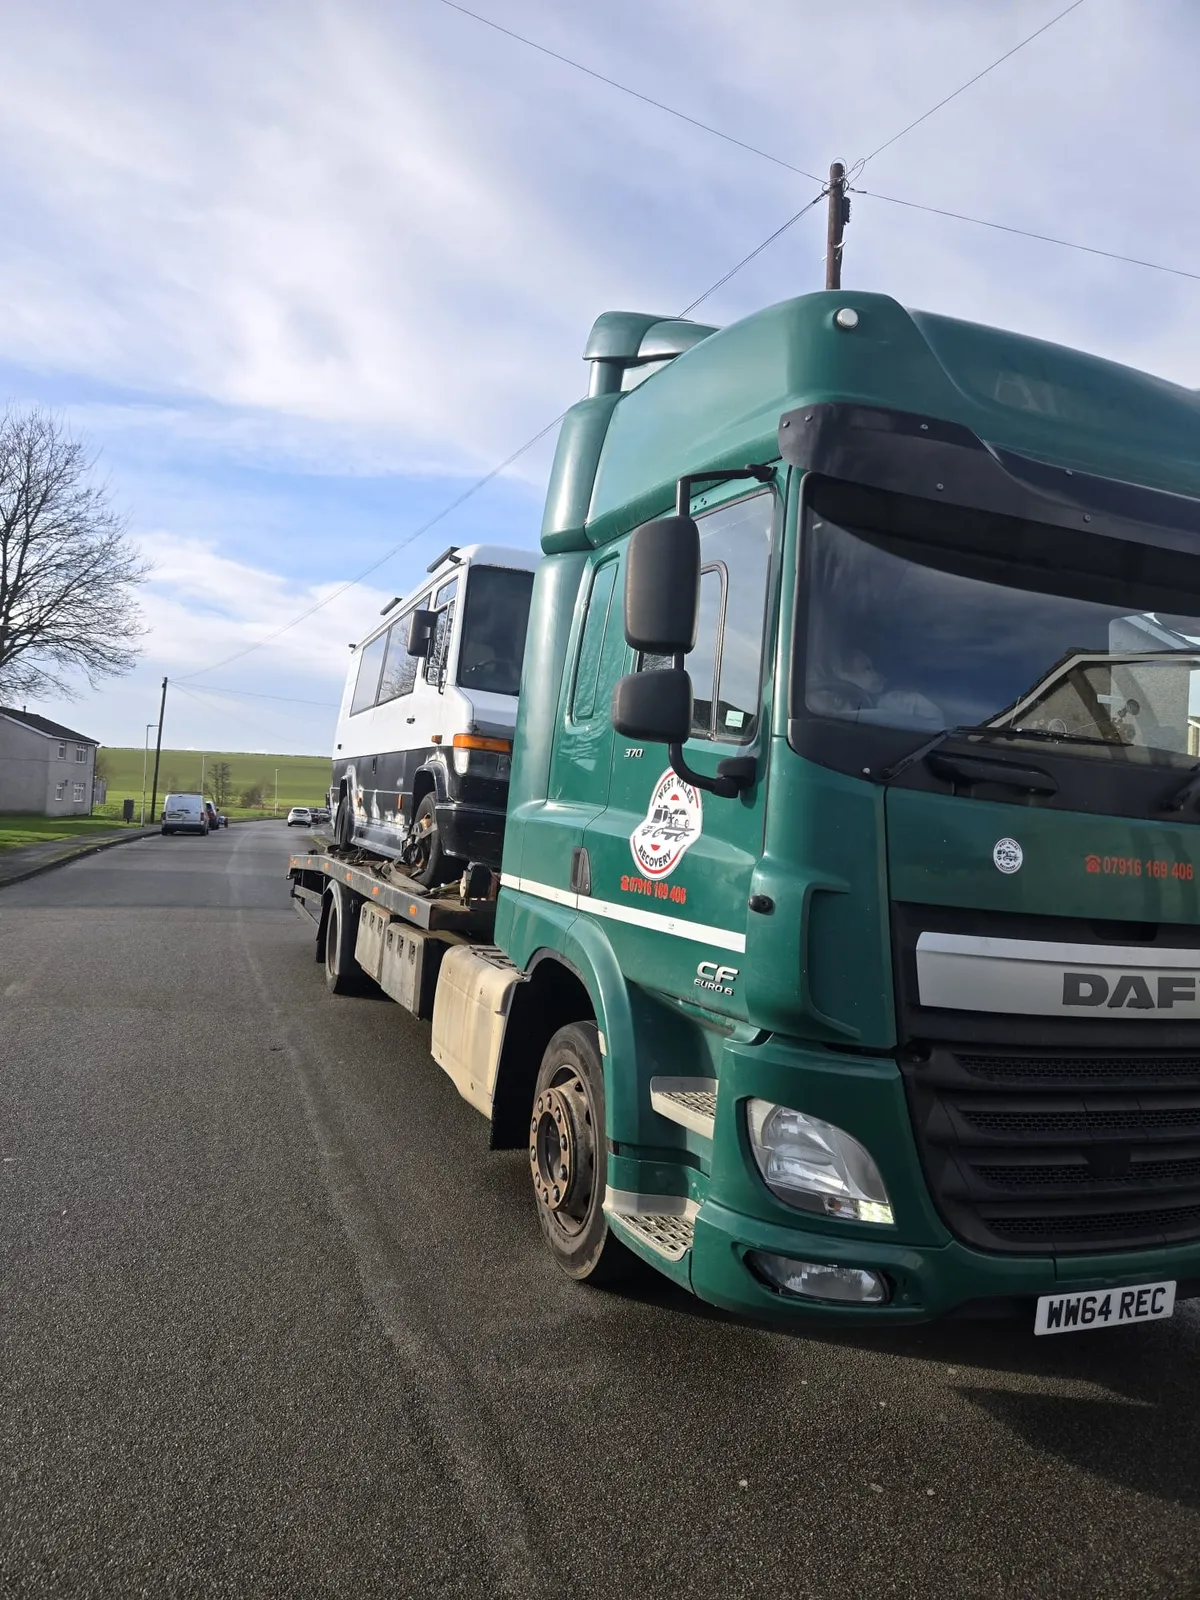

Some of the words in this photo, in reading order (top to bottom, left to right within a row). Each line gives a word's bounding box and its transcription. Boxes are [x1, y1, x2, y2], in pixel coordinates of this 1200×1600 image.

[624, 748, 644, 758] 370
[658, 778, 675, 800] WEST
[677, 777, 695, 804] WALES
[638, 845, 672, 868] RECOVERY
[1103, 856, 1142, 877] 07916
[1146, 860, 1168, 878] 169
[1171, 861, 1193, 880] 406
[629, 877, 652, 896] 07916
[653, 881, 669, 899] 169
[669, 885, 687, 904] 406
[697, 961, 739, 983] CF
[693, 978, 724, 993] EURO
[724, 987, 734, 996] 6
[1062, 972, 1196, 1009] DAF
[1047, 1294, 1112, 1329] WW64
[1118, 1287, 1166, 1319] REC
